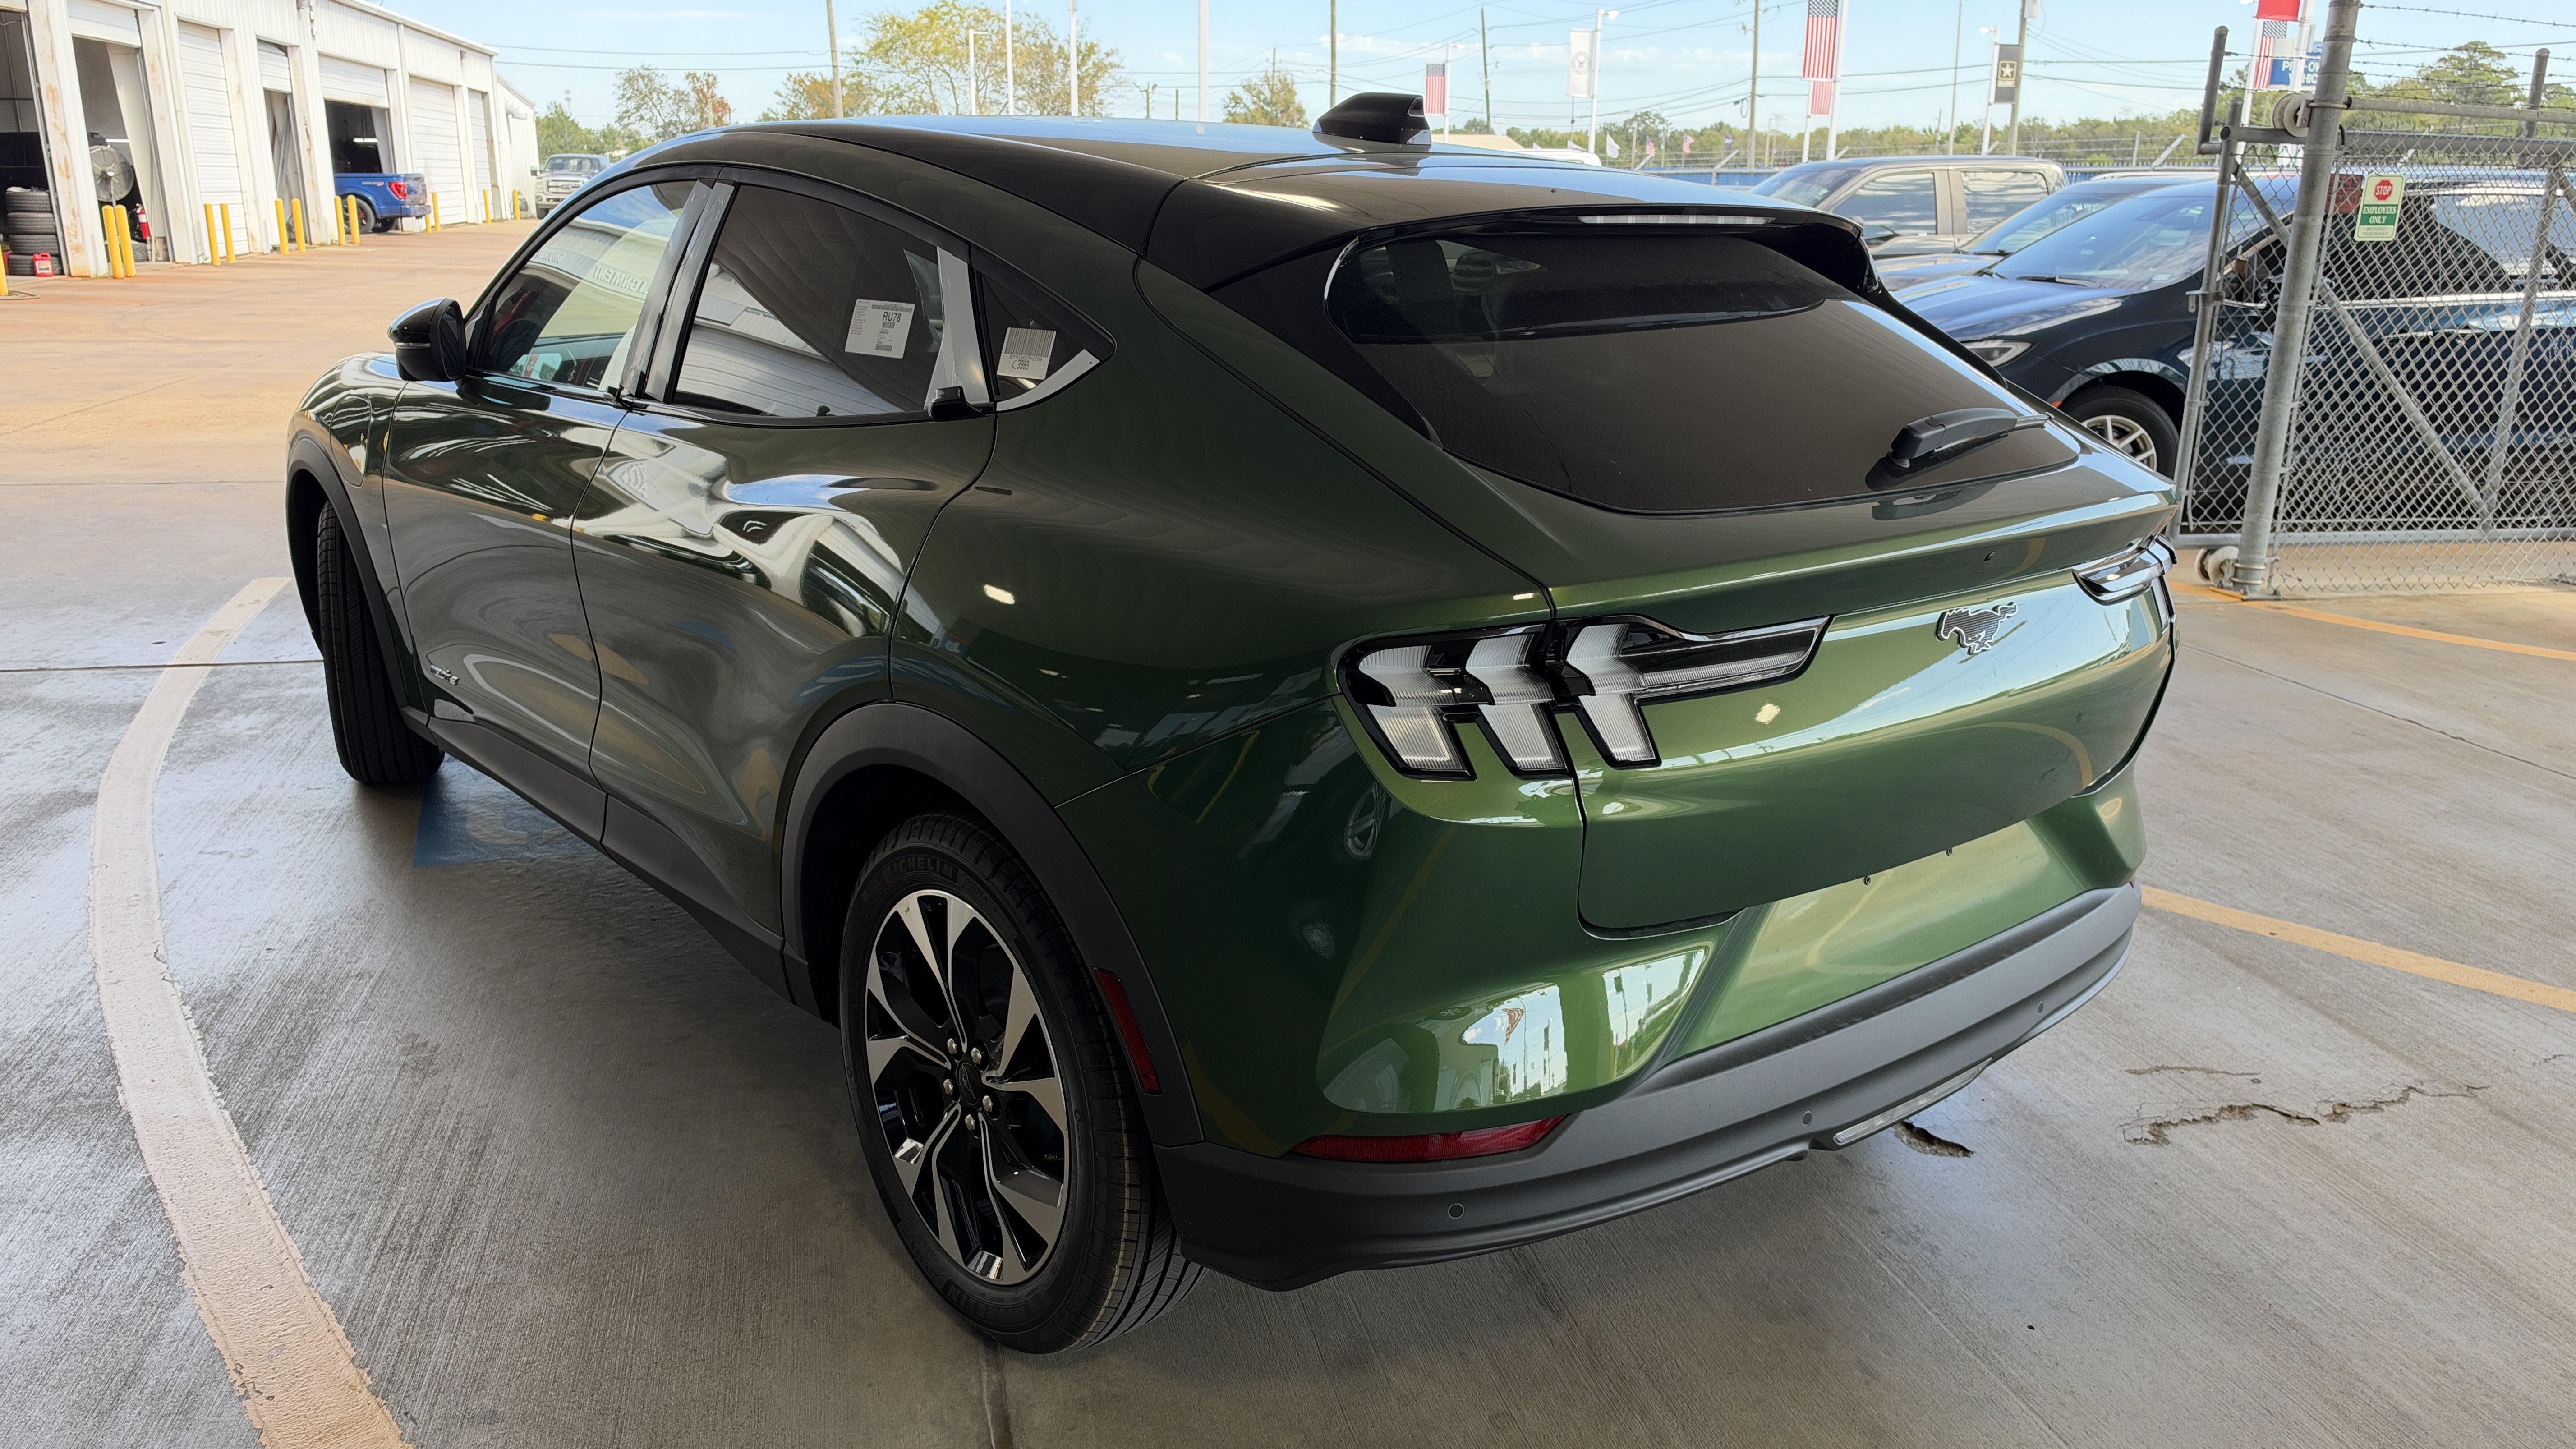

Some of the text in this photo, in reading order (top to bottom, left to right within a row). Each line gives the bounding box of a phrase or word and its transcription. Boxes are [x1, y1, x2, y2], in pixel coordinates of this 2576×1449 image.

[2375, 185, 2392, 195] STOP
[2363, 206, 2396, 214] EMPLOYEES
[882, 312, 902, 322] RU78
[883, 856, 1000, 914] MICHELIN PRIMACY
